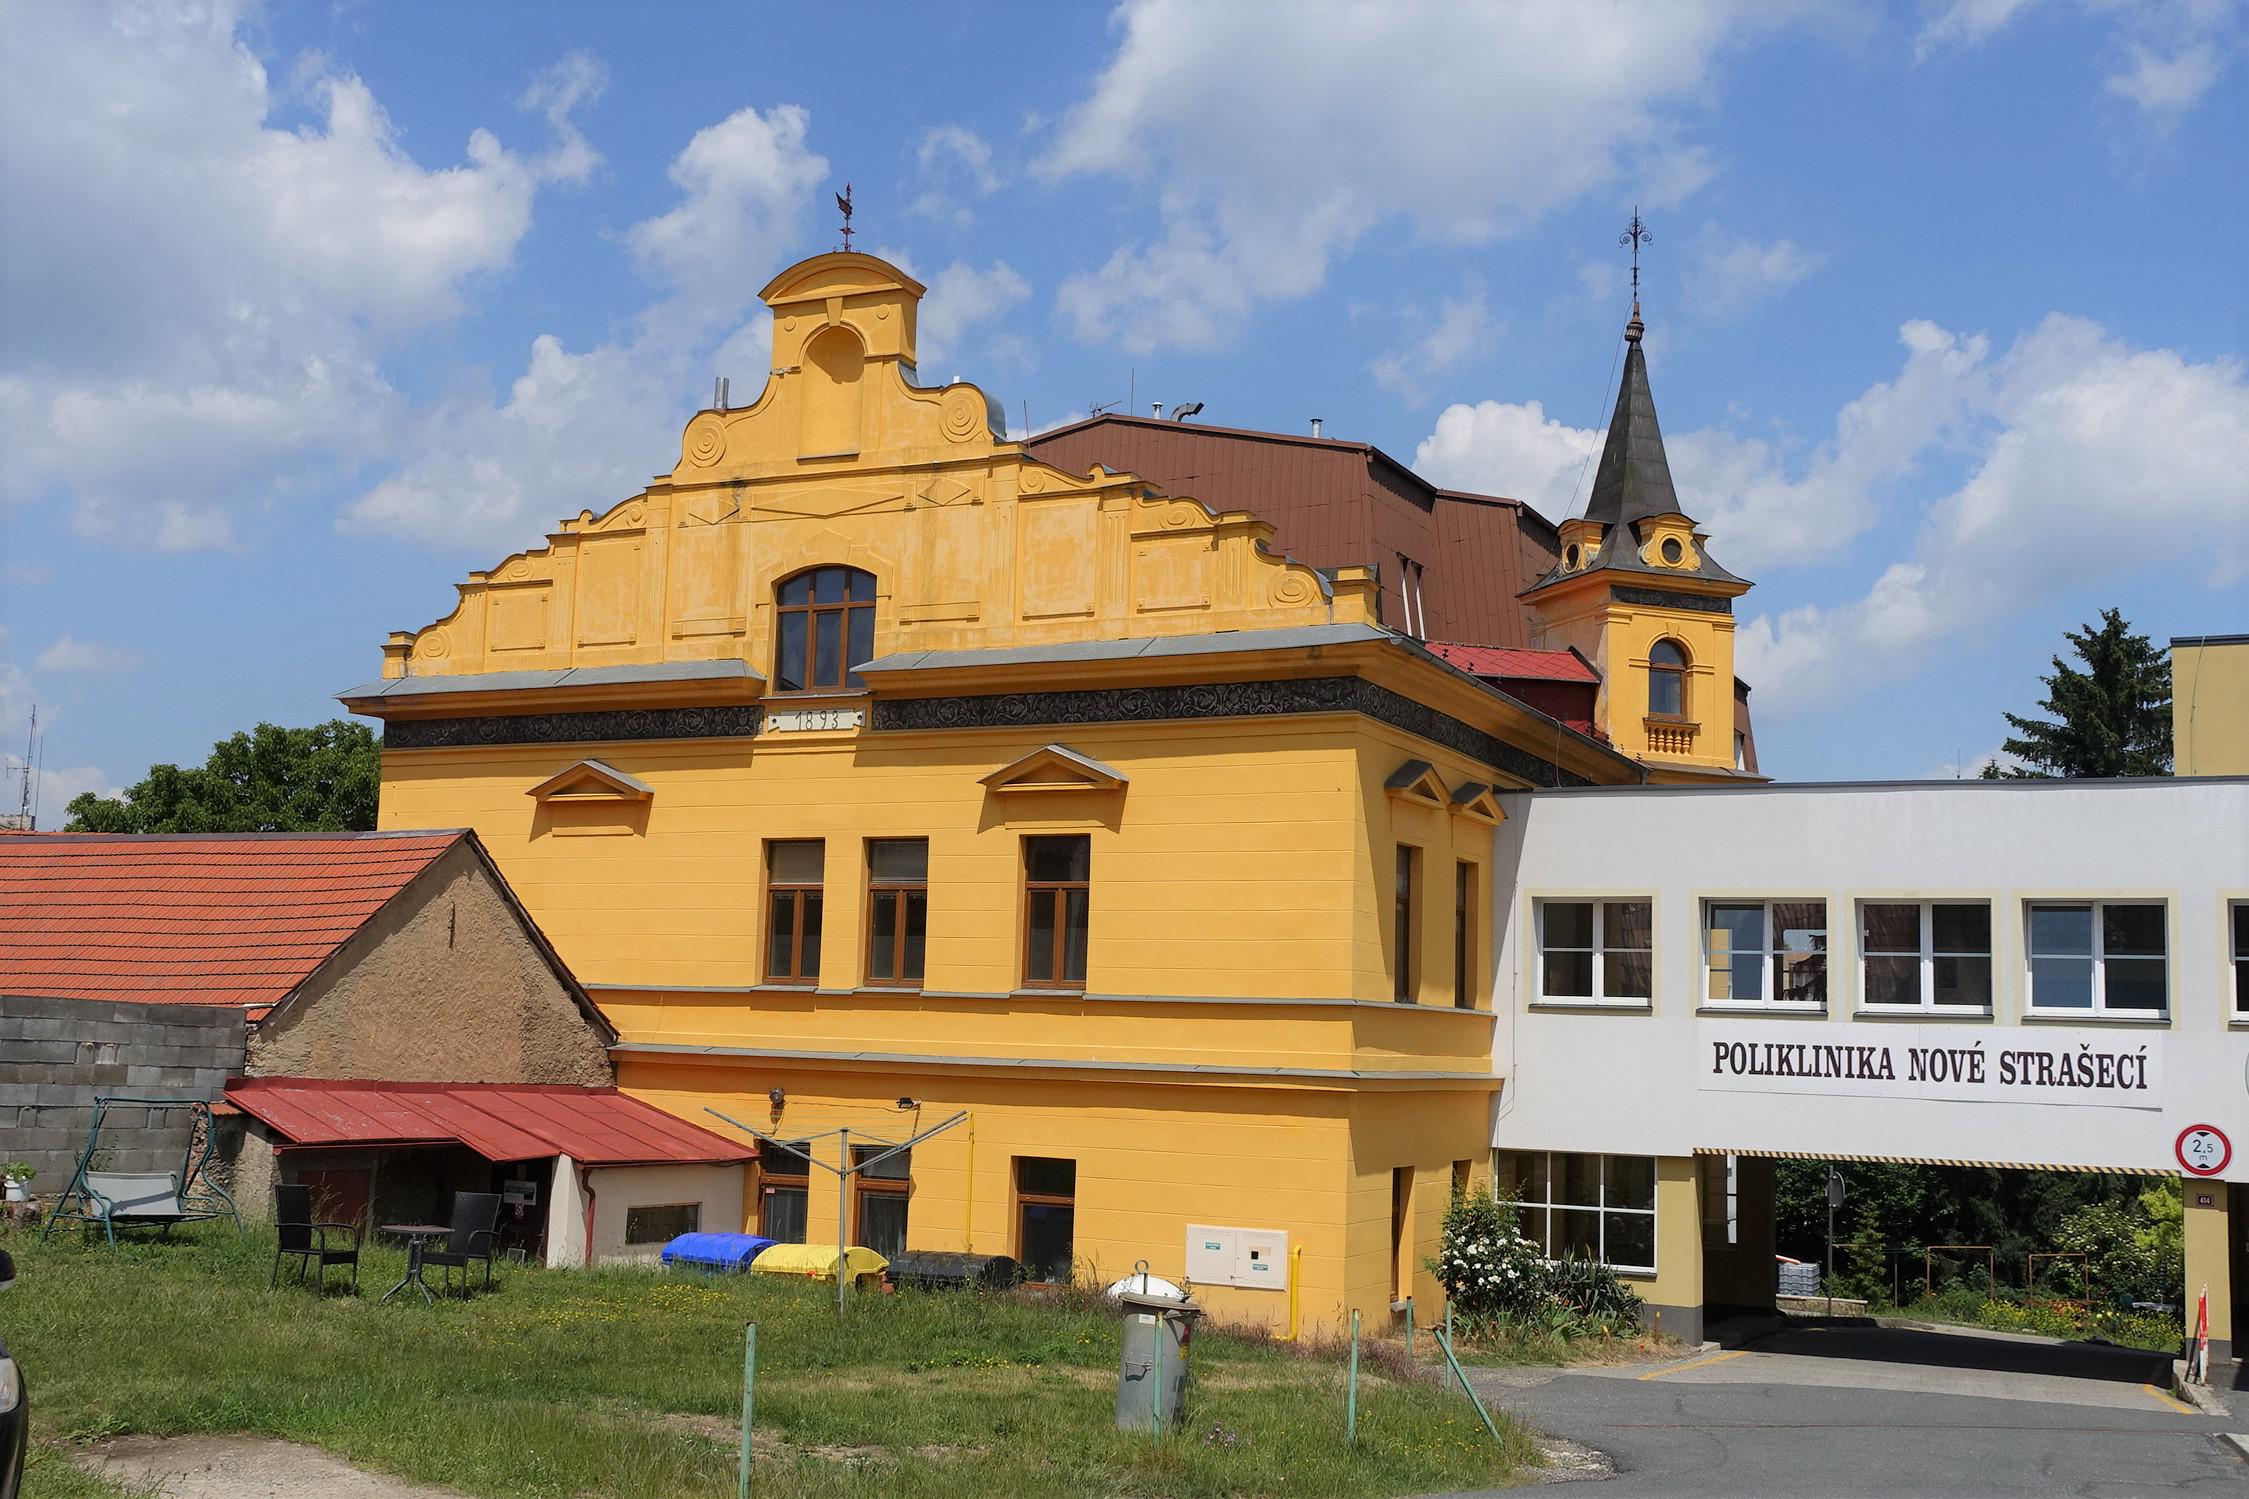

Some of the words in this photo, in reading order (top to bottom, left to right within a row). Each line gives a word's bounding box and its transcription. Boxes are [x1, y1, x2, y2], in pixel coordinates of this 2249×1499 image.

[795, 710, 839, 731] 1893
[1713, 1041, 1896, 1081] POLIKLINIKA
[1908, 1040, 1985, 1084] NOVÉ
[1999, 1043, 2148, 1090] STRAŠECÍ
